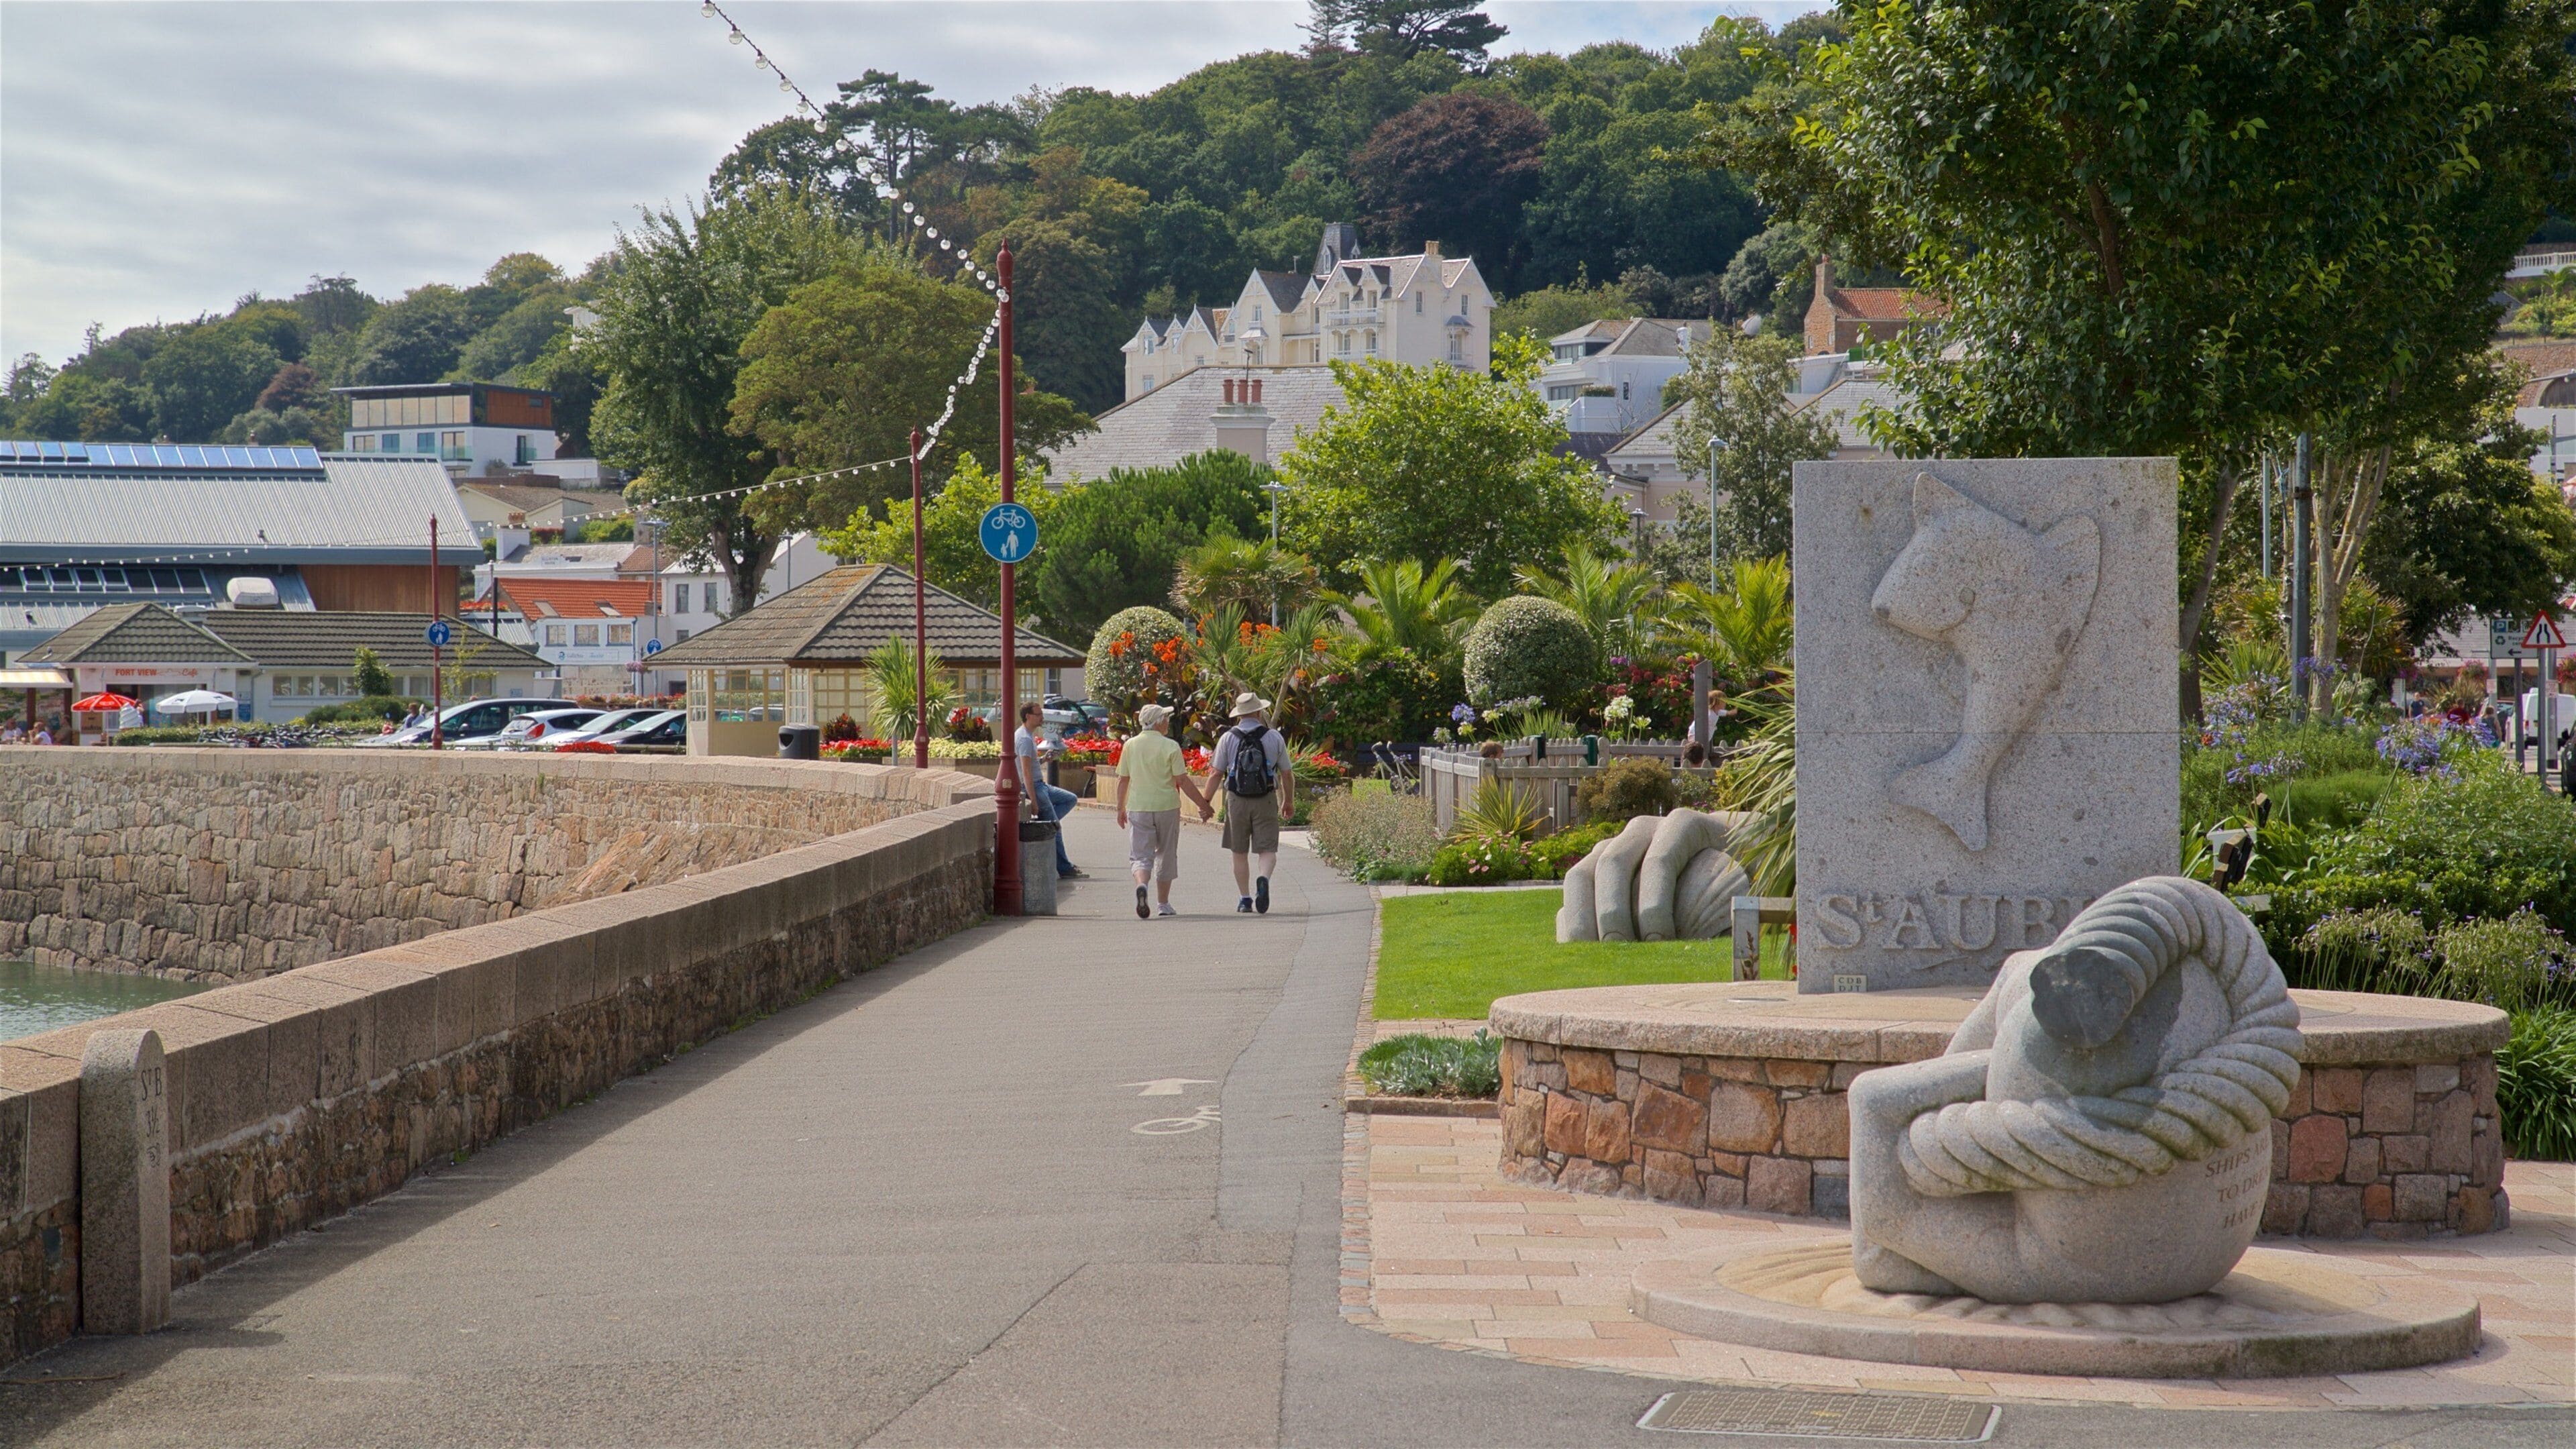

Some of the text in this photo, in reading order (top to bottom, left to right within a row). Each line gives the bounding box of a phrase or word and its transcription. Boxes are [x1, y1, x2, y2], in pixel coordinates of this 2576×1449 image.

[155, 1067, 162, 1096] B
[2206, 1147, 2251, 1177] SHIPS
[2217, 1184, 2239, 1202] TO
